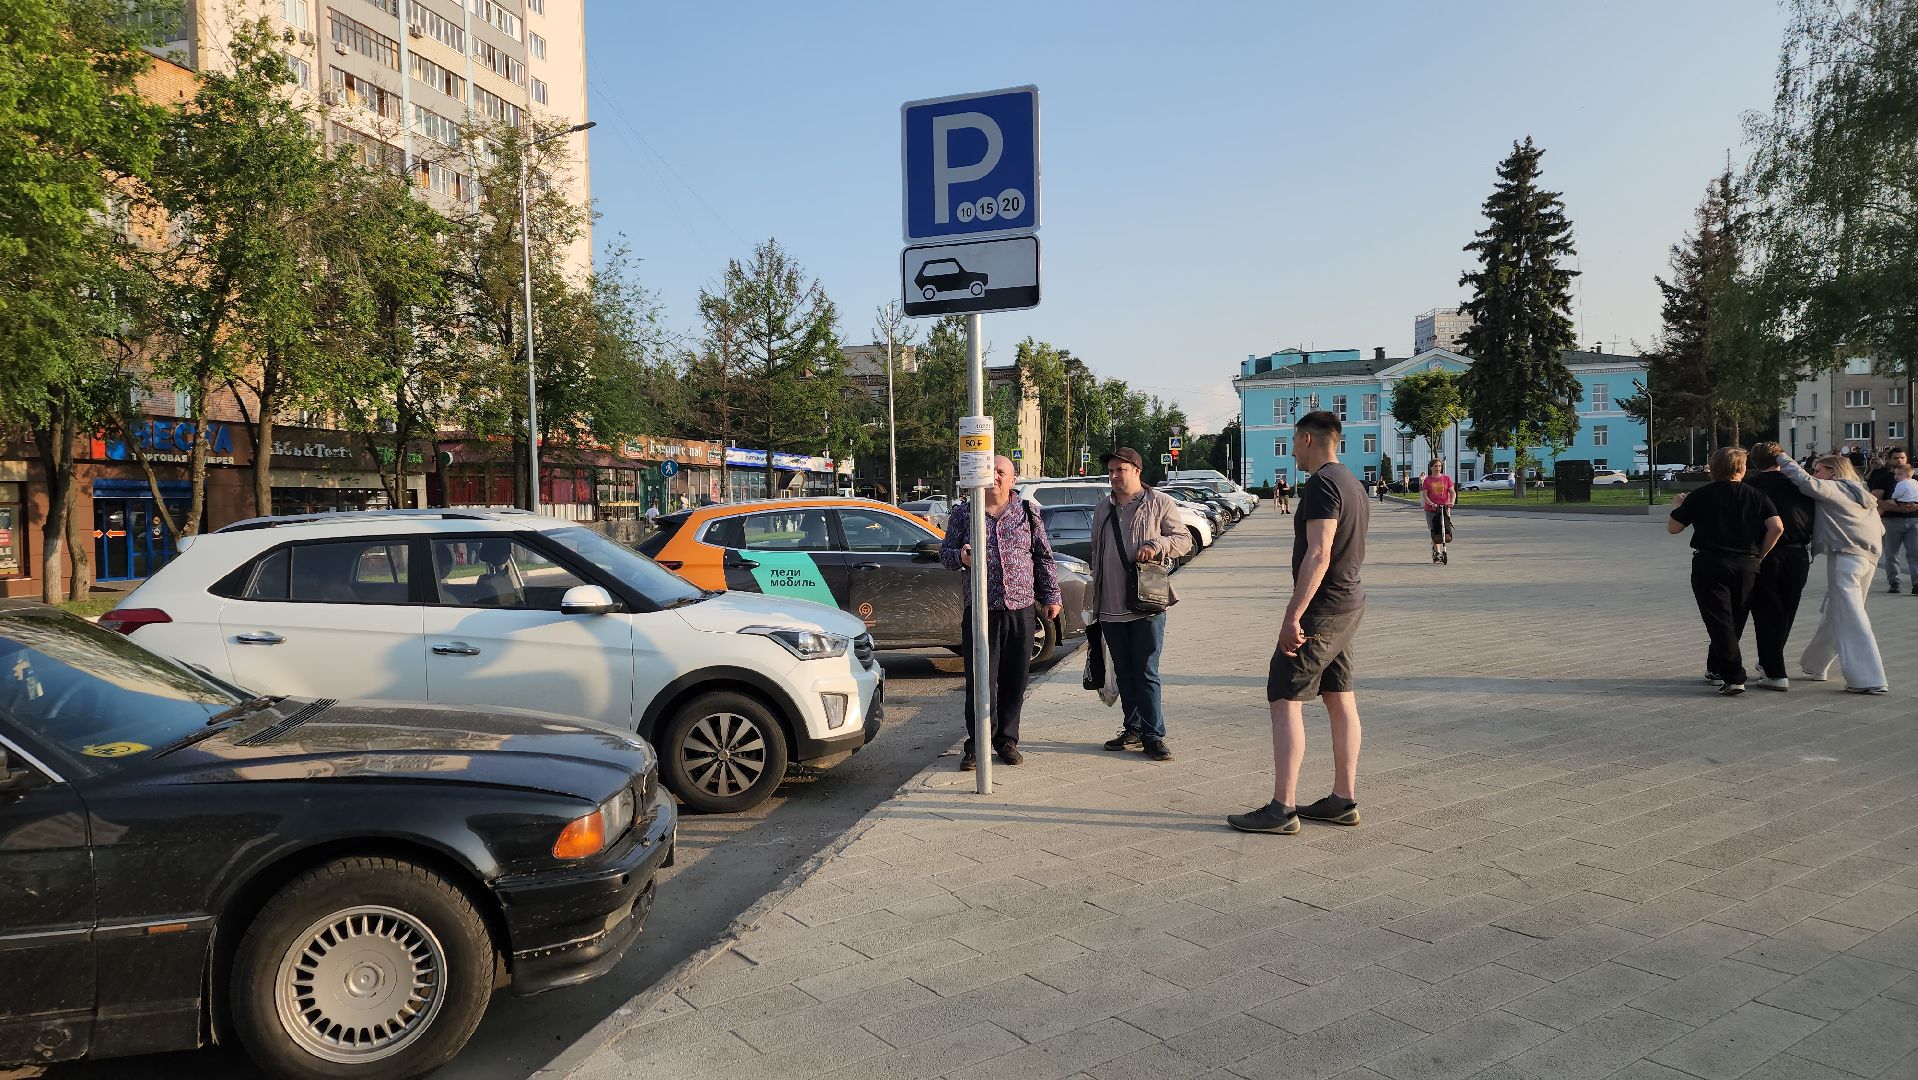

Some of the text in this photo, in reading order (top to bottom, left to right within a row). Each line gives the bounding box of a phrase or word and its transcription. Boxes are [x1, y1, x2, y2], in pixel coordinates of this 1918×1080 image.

[933, 111, 1004, 224] P
[960, 197, 1020, 218] 10 15 20
[770, 568, 801, 578] дели
[770, 577, 816, 586] мобиль
